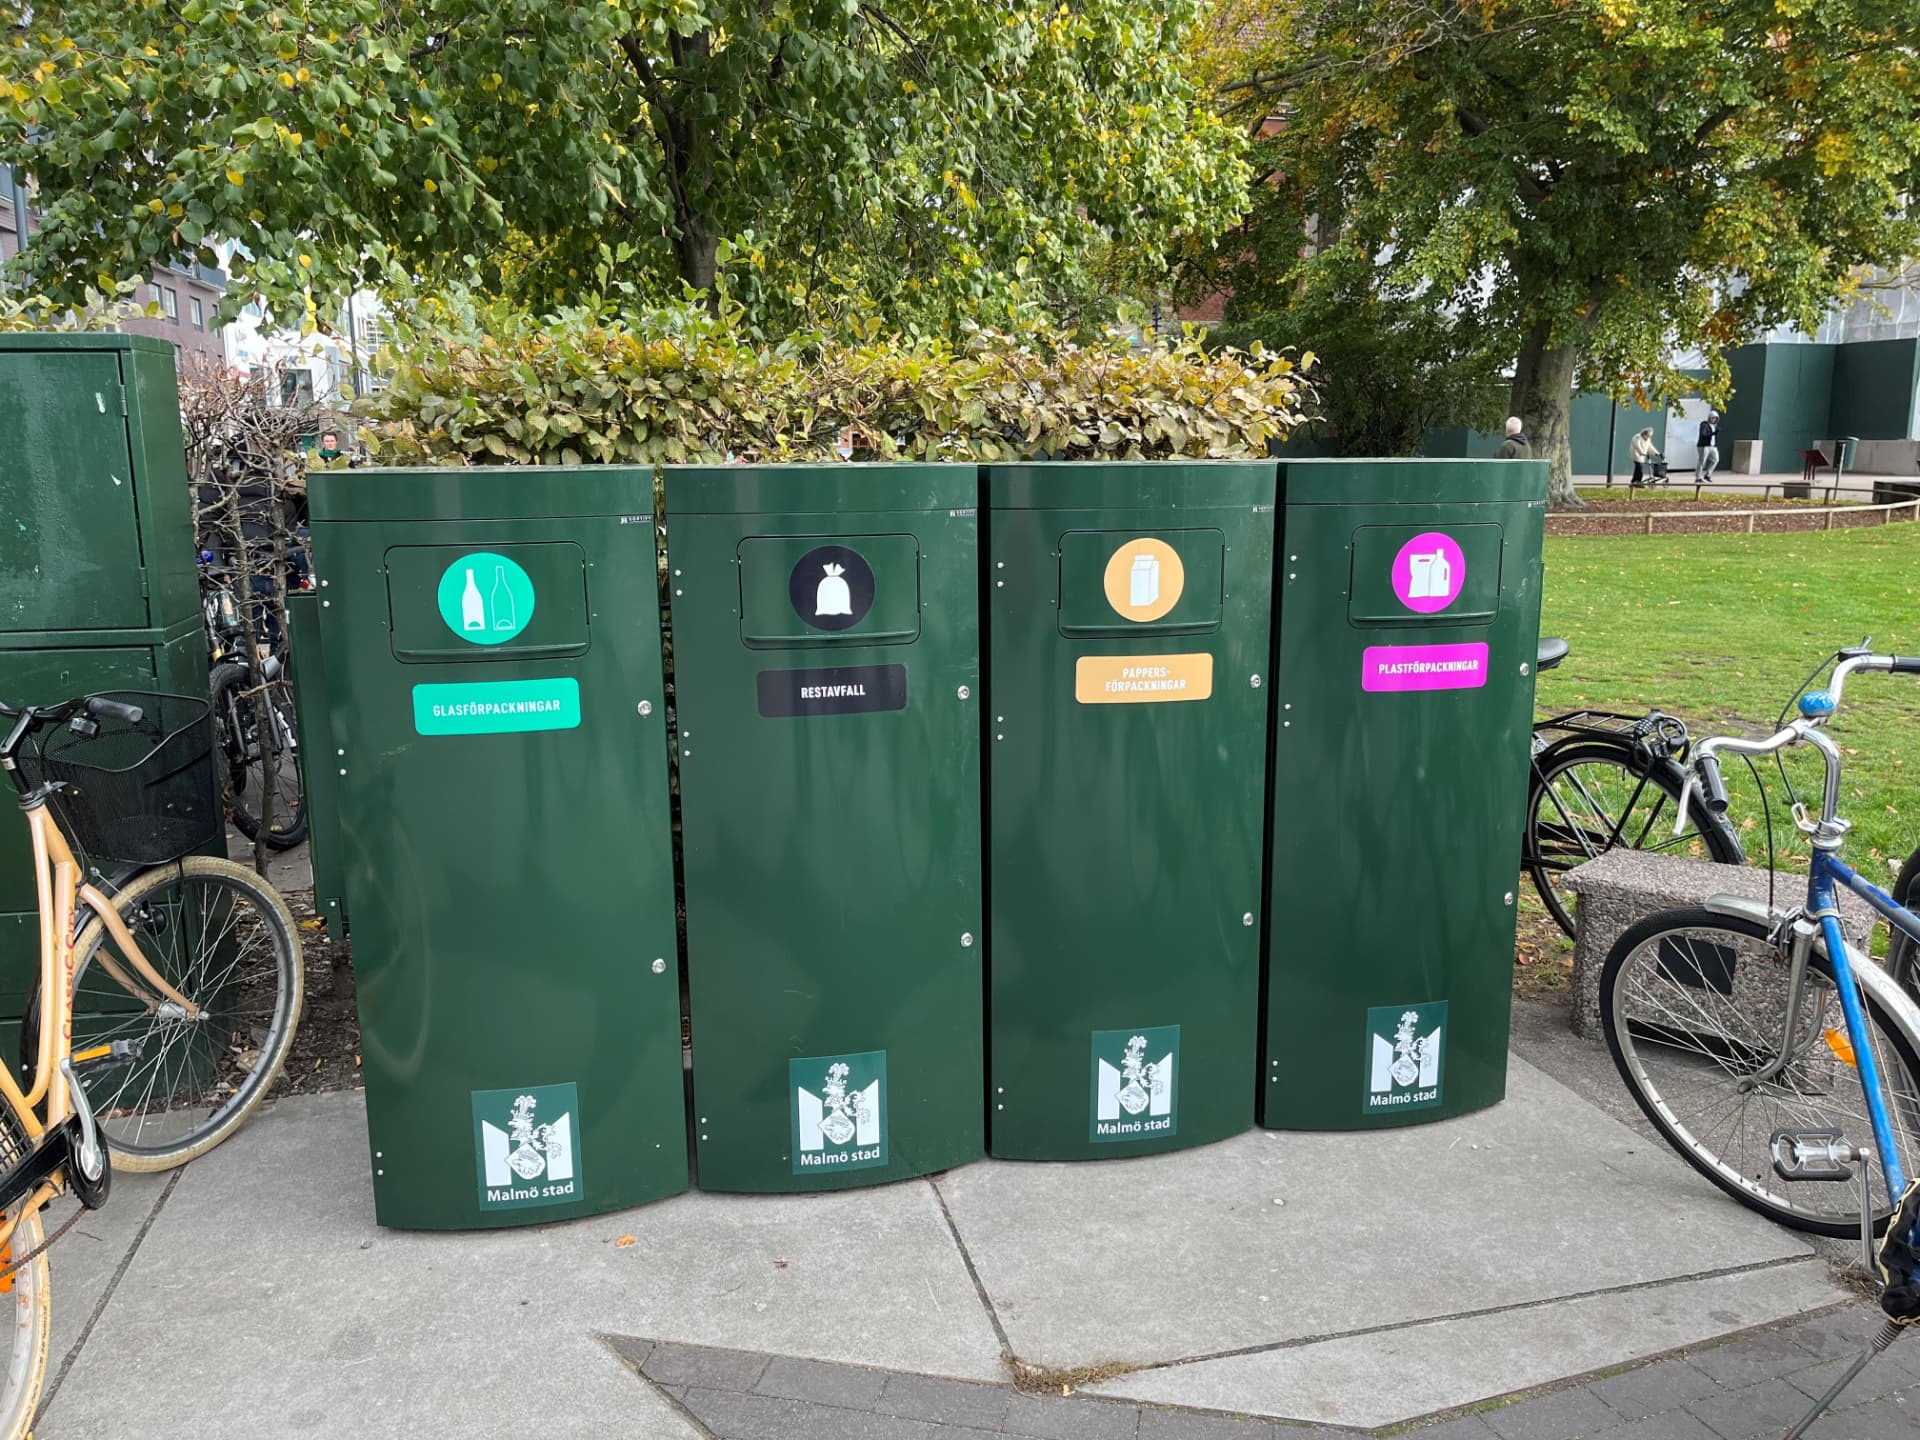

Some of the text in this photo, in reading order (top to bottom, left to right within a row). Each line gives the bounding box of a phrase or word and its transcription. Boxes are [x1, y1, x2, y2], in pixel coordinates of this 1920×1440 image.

[1122, 667, 1171, 679] PAPPERS-
[1378, 660, 1478, 675] PLASTFÖRPACKNINGAR
[801, 684, 866, 699] RESTAVFALL
[1105, 679, 1186, 692] FÖRPACKNINGAR
[432, 699, 561, 717] GLASFÖRPACKNINGAR
[1370, 1088, 1437, 1106] Malmö stad
[1097, 1116, 1170, 1135] Malmö stad
[801, 1146, 880, 1166] Malmö stad
[487, 1181, 574, 1202] Malmö stad
